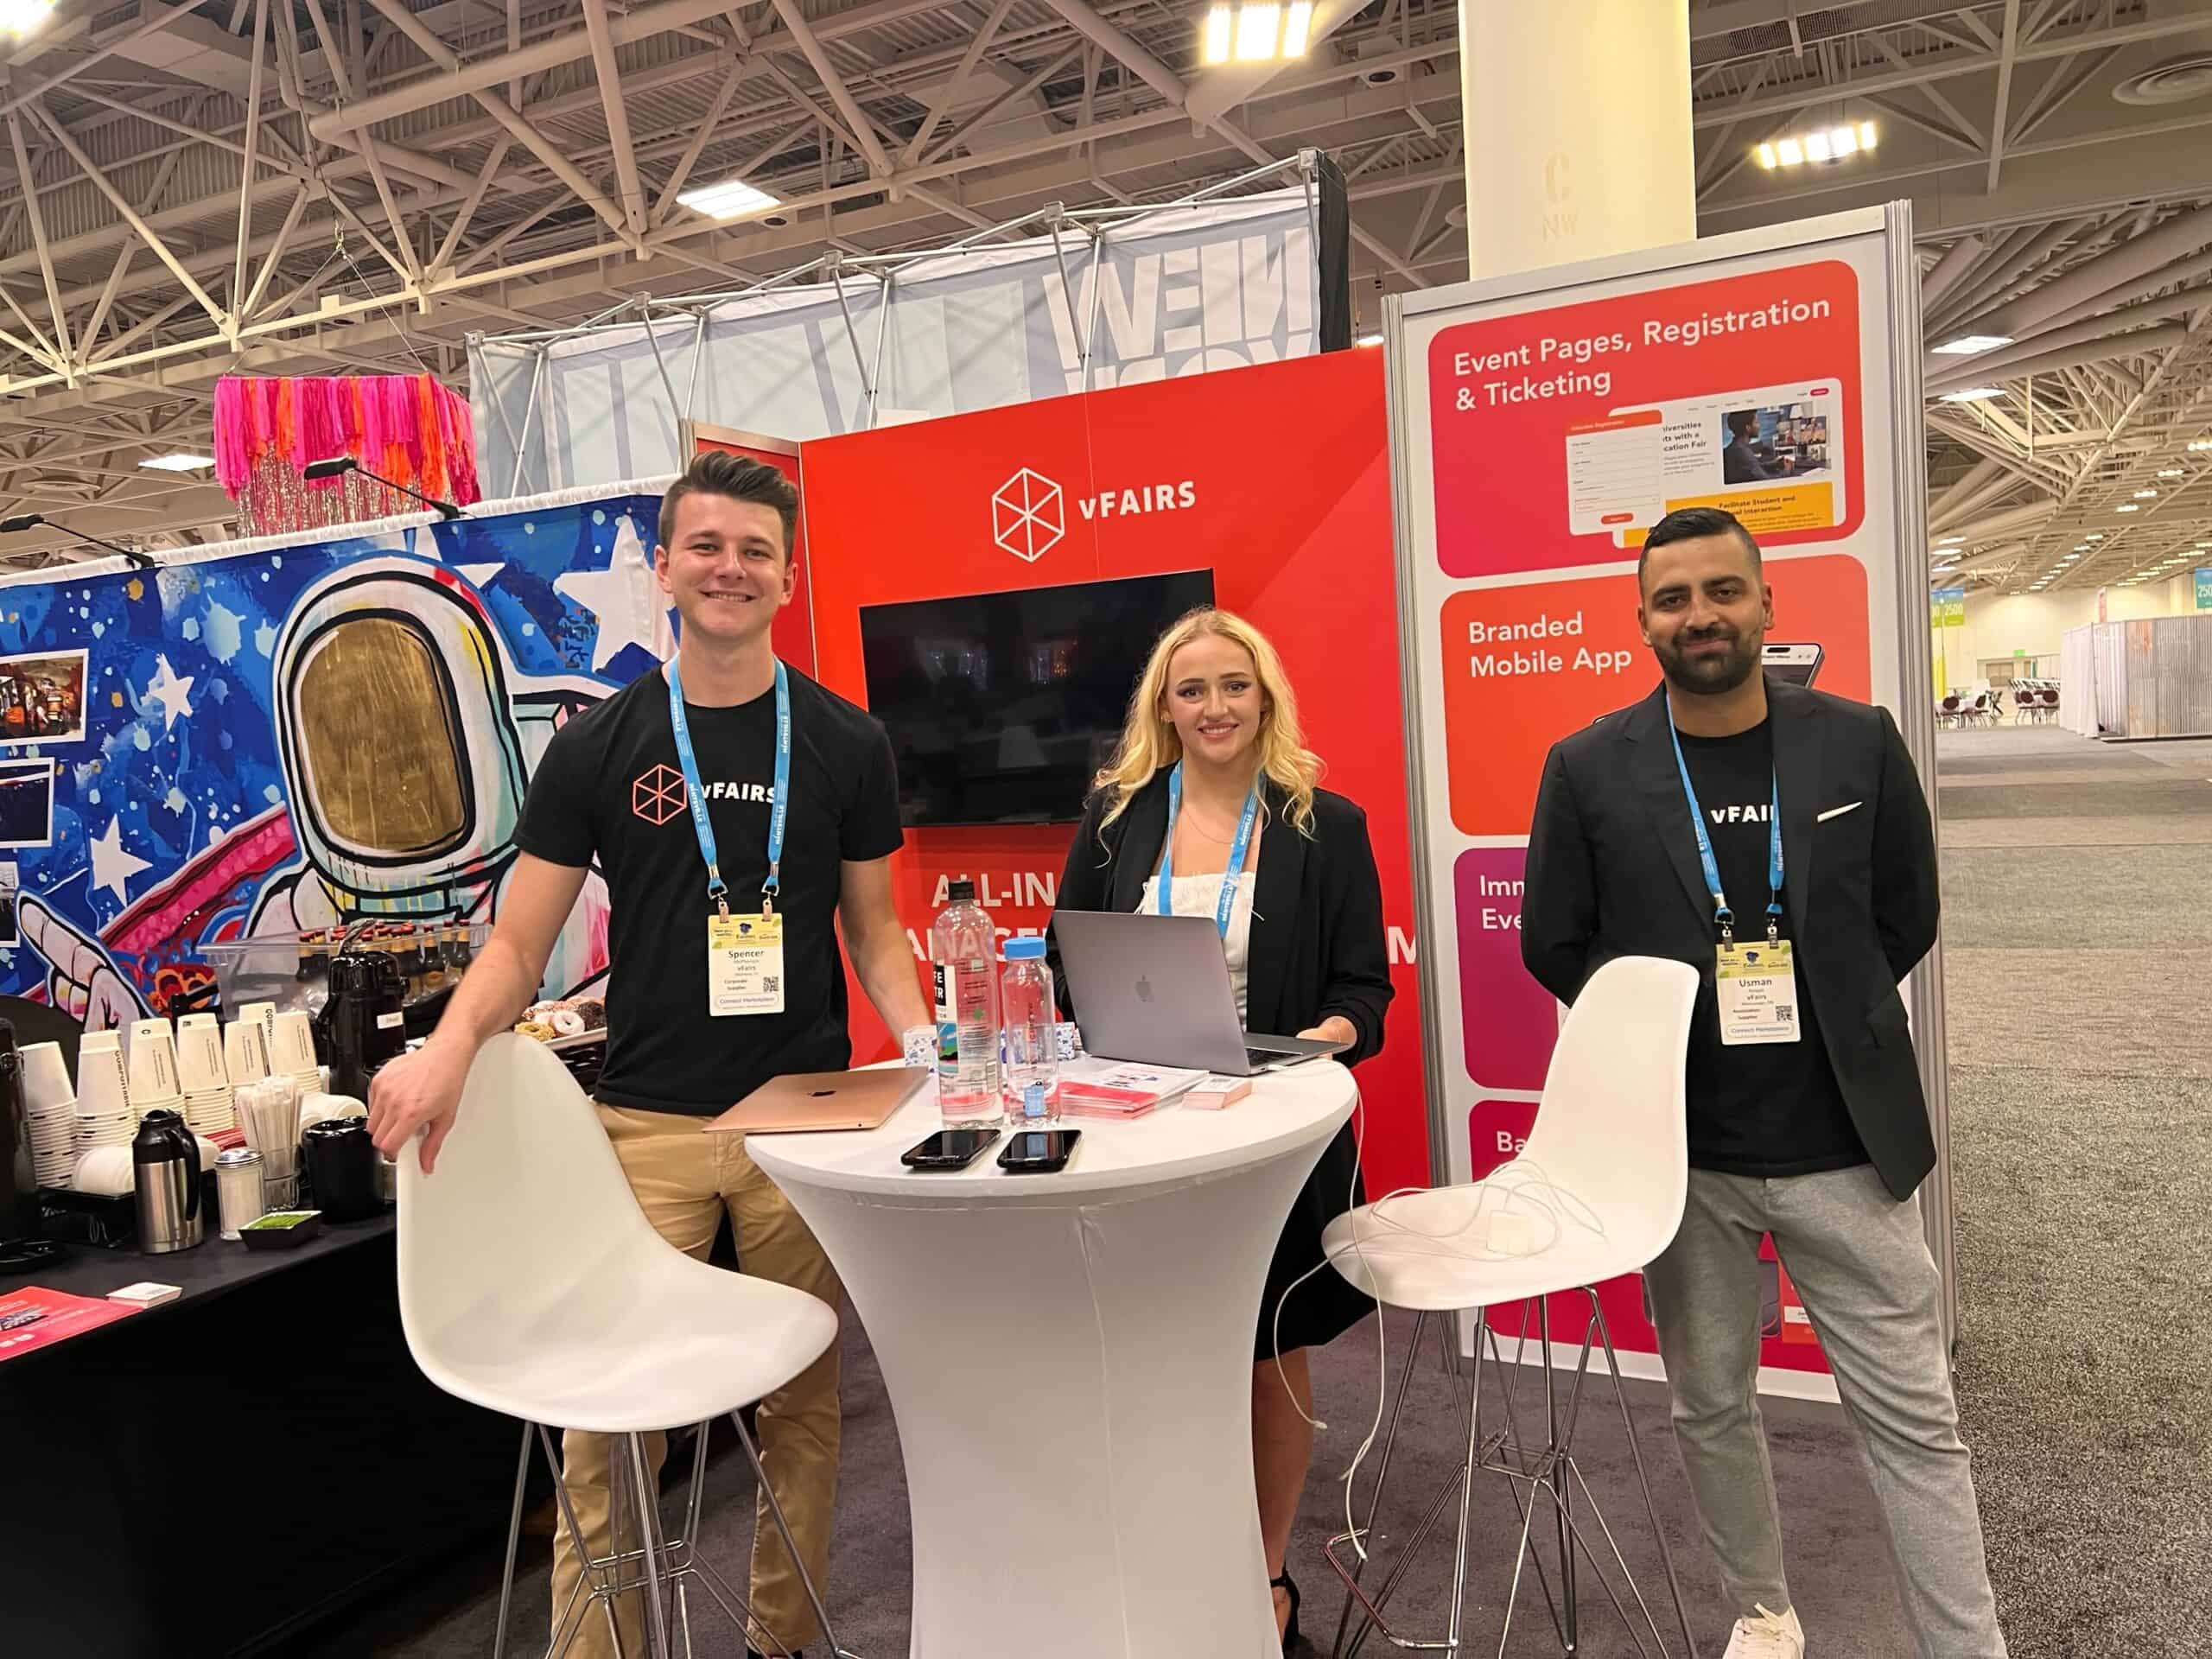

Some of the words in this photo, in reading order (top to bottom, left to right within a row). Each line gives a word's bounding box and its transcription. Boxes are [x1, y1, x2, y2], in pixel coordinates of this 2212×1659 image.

[1546, 154, 1570, 202] C
[1453, 346, 1531, 376] Event
[1540, 332, 1633, 364] Pages,
[1643, 298, 1831, 346] Registration
[1455, 387, 1477, 411] &
[1484, 370, 1612, 408] Ticketing
[1675, 431, 1693, 442] with
[1691, 440, 1707, 449] Fair
[1077, 480, 1197, 520] vFAIRS
[1718, 500, 1751, 510] Facilitate
[1752, 496, 1780, 506] Student
[1782, 494, 1796, 503] and
[1469, 611, 1583, 644] Branded
[1471, 650, 1563, 678] Mobile
[1572, 647, 1632, 675] App
[701, 782, 775, 804] vFAIRS
[1710, 804, 1774, 824] vFAI
